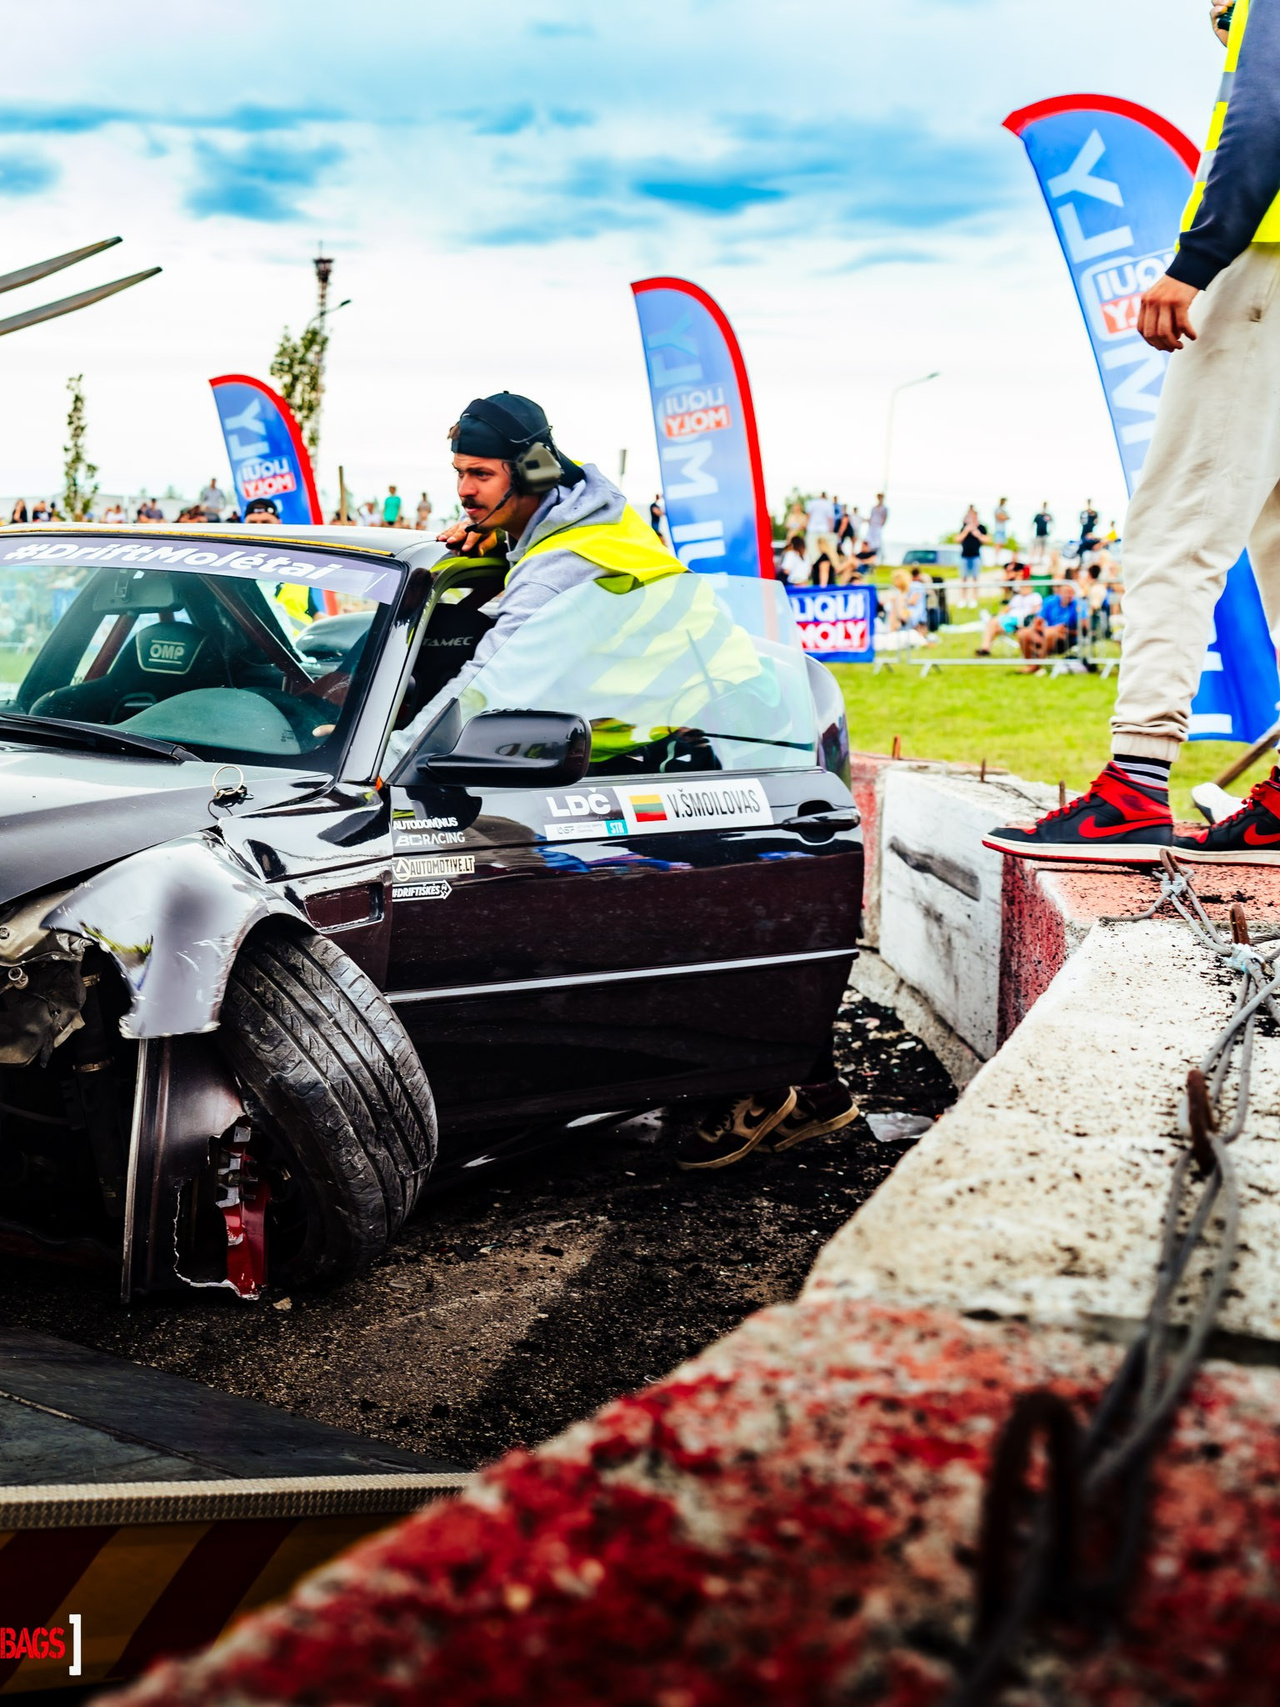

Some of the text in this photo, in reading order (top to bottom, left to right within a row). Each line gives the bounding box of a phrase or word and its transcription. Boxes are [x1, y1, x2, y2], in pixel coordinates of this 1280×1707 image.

[150, 644, 184, 659] OMP
[666, 789, 760, 818] V.ŠMOILOVAS
[410, 858, 473, 876] AUTOMOTIVE.LT
